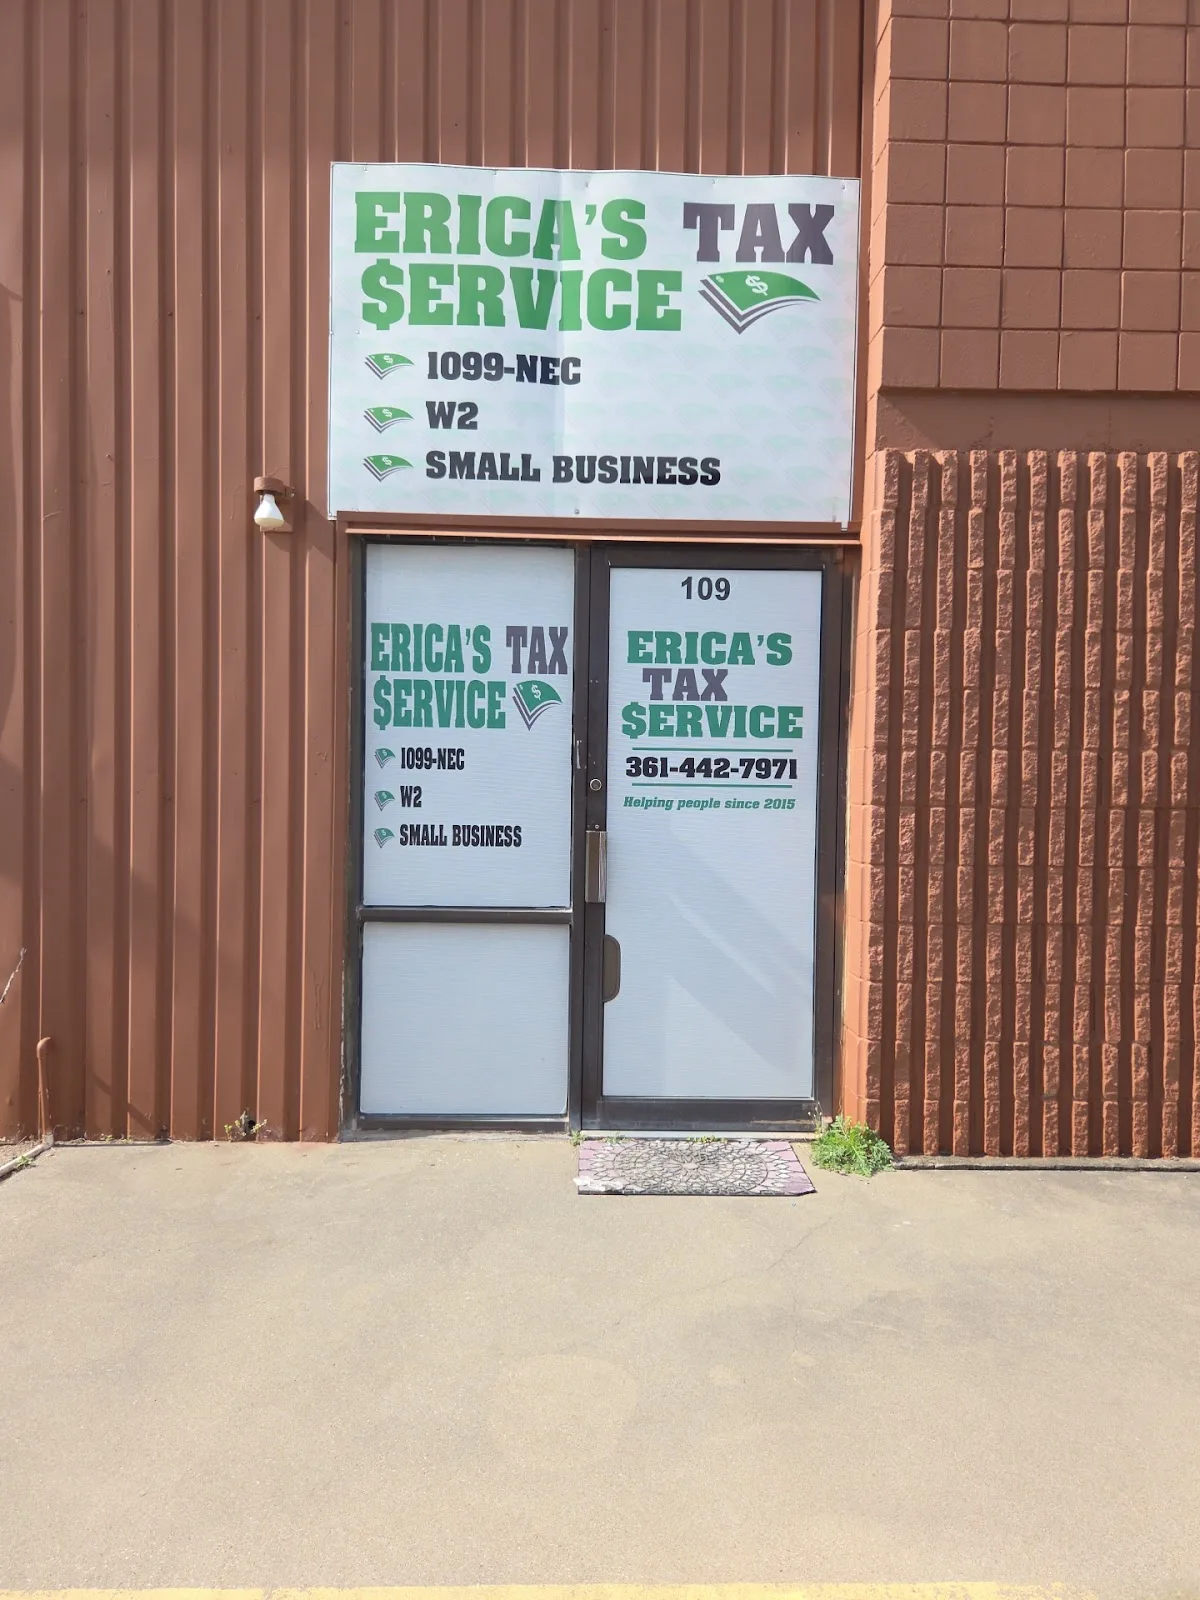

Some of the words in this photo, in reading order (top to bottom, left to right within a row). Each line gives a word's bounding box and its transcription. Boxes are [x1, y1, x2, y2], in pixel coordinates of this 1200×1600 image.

[354, 191, 647, 261] ERICA'S
[682, 202, 835, 266] TAX
[360, 257, 683, 331] $ERVICE
[426, 351, 582, 385] 1099-NEC
[425, 400, 479, 430] W2
[425, 450, 541, 482] SMALL
[552, 455, 721, 486] BUSINESS
[681, 576, 731, 601] 109
[370, 622, 492, 674] ERICA'S
[505, 625, 569, 675] TAX
[627, 630, 793, 667] ERICA'S
[642, 667, 729, 702] TAX
[373, 674, 507, 731] $ERVICE
[621, 701, 804, 739] $ERVICE
[400, 747, 465, 770] 1099-NEC
[625, 756, 798, 780] 361-442-7971
[400, 785, 422, 808] W2
[623, 796, 674, 811] Helping
[676, 798, 721, 811] people
[724, 798, 760, 809] since
[763, 798, 796, 810] 2015
[399, 823, 448, 847] SMALL
[451, 824, 522, 848] BUSINESS
